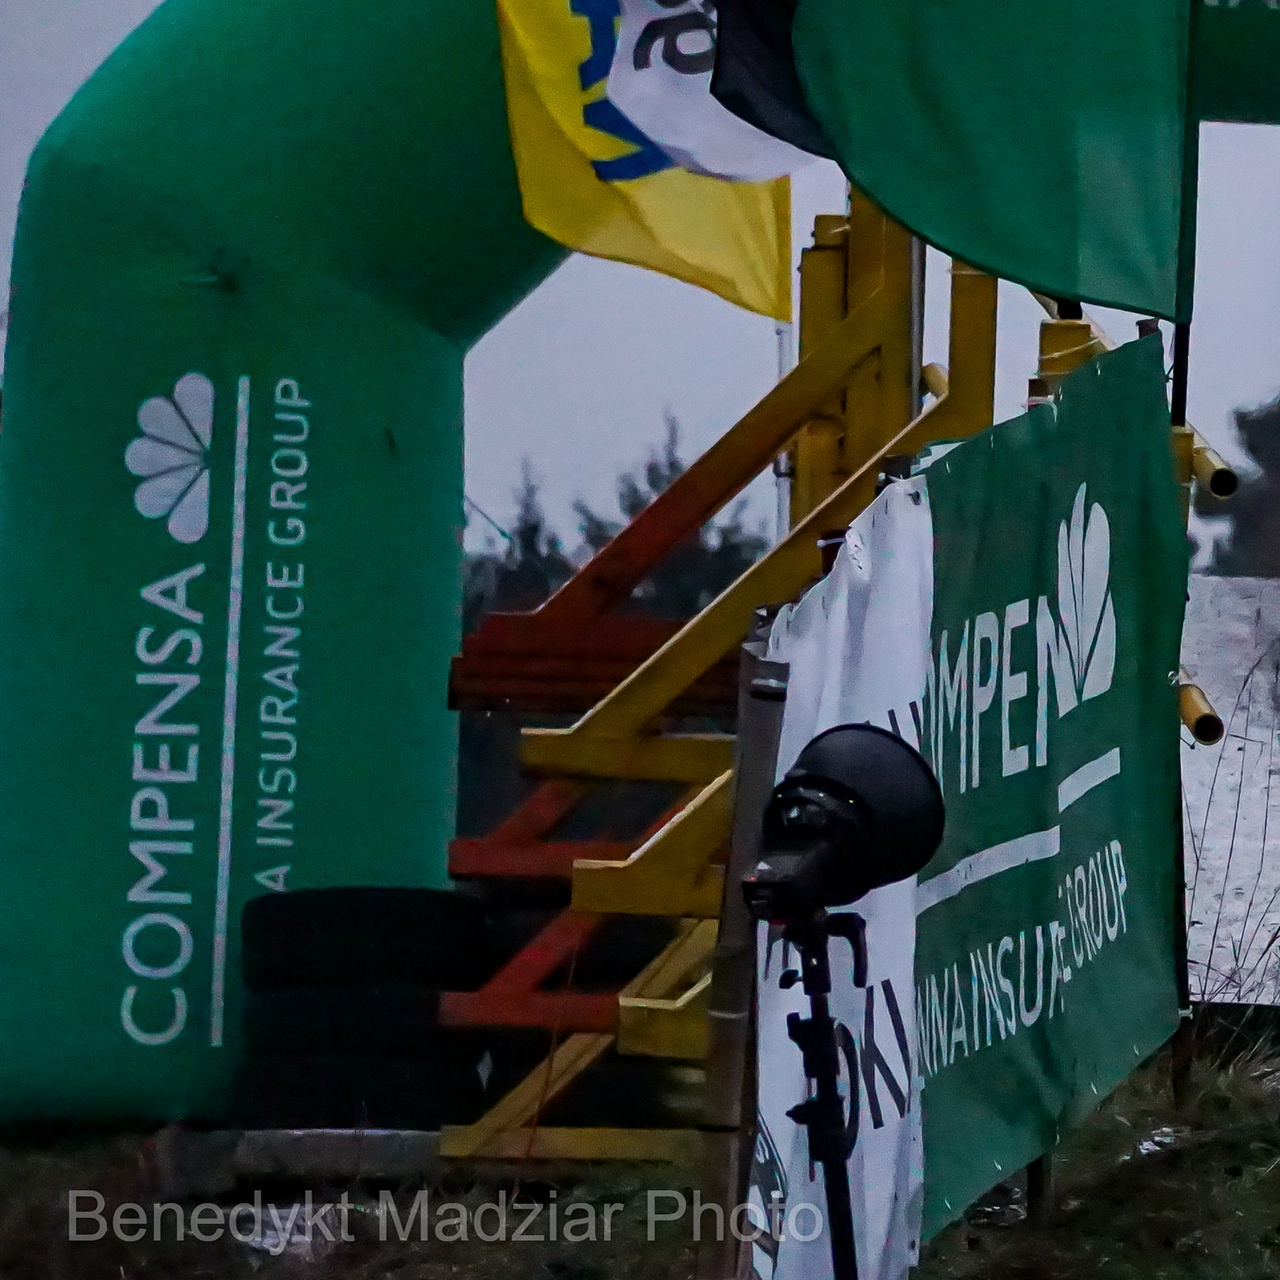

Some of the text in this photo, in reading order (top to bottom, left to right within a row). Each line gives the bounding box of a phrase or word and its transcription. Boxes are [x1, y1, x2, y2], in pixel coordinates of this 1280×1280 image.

[269, 377, 312, 549] GROUP
[120, 561, 205, 1047] COMPENSA
[257, 559, 305, 852] INSURANCE
[926, 594, 1080, 797] MPEN
